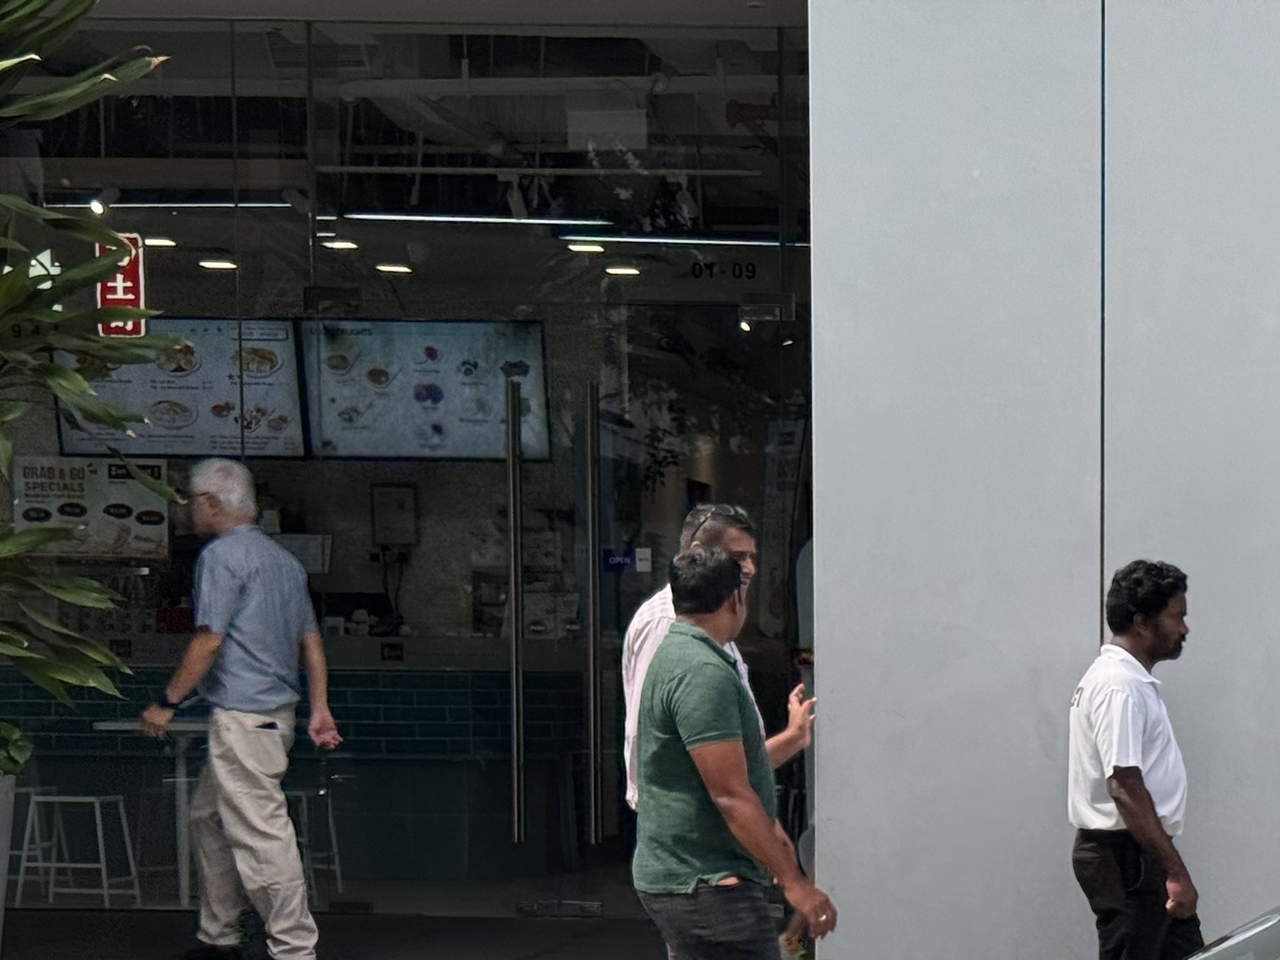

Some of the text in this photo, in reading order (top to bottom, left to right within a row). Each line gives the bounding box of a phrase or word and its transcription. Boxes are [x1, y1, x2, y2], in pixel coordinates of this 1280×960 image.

[23, 466, 55, 480] GRAB
[70, 466, 85, 480] GO
[24, 481, 85, 493] SPECIALS
[608, 555, 631, 565] OPEN
